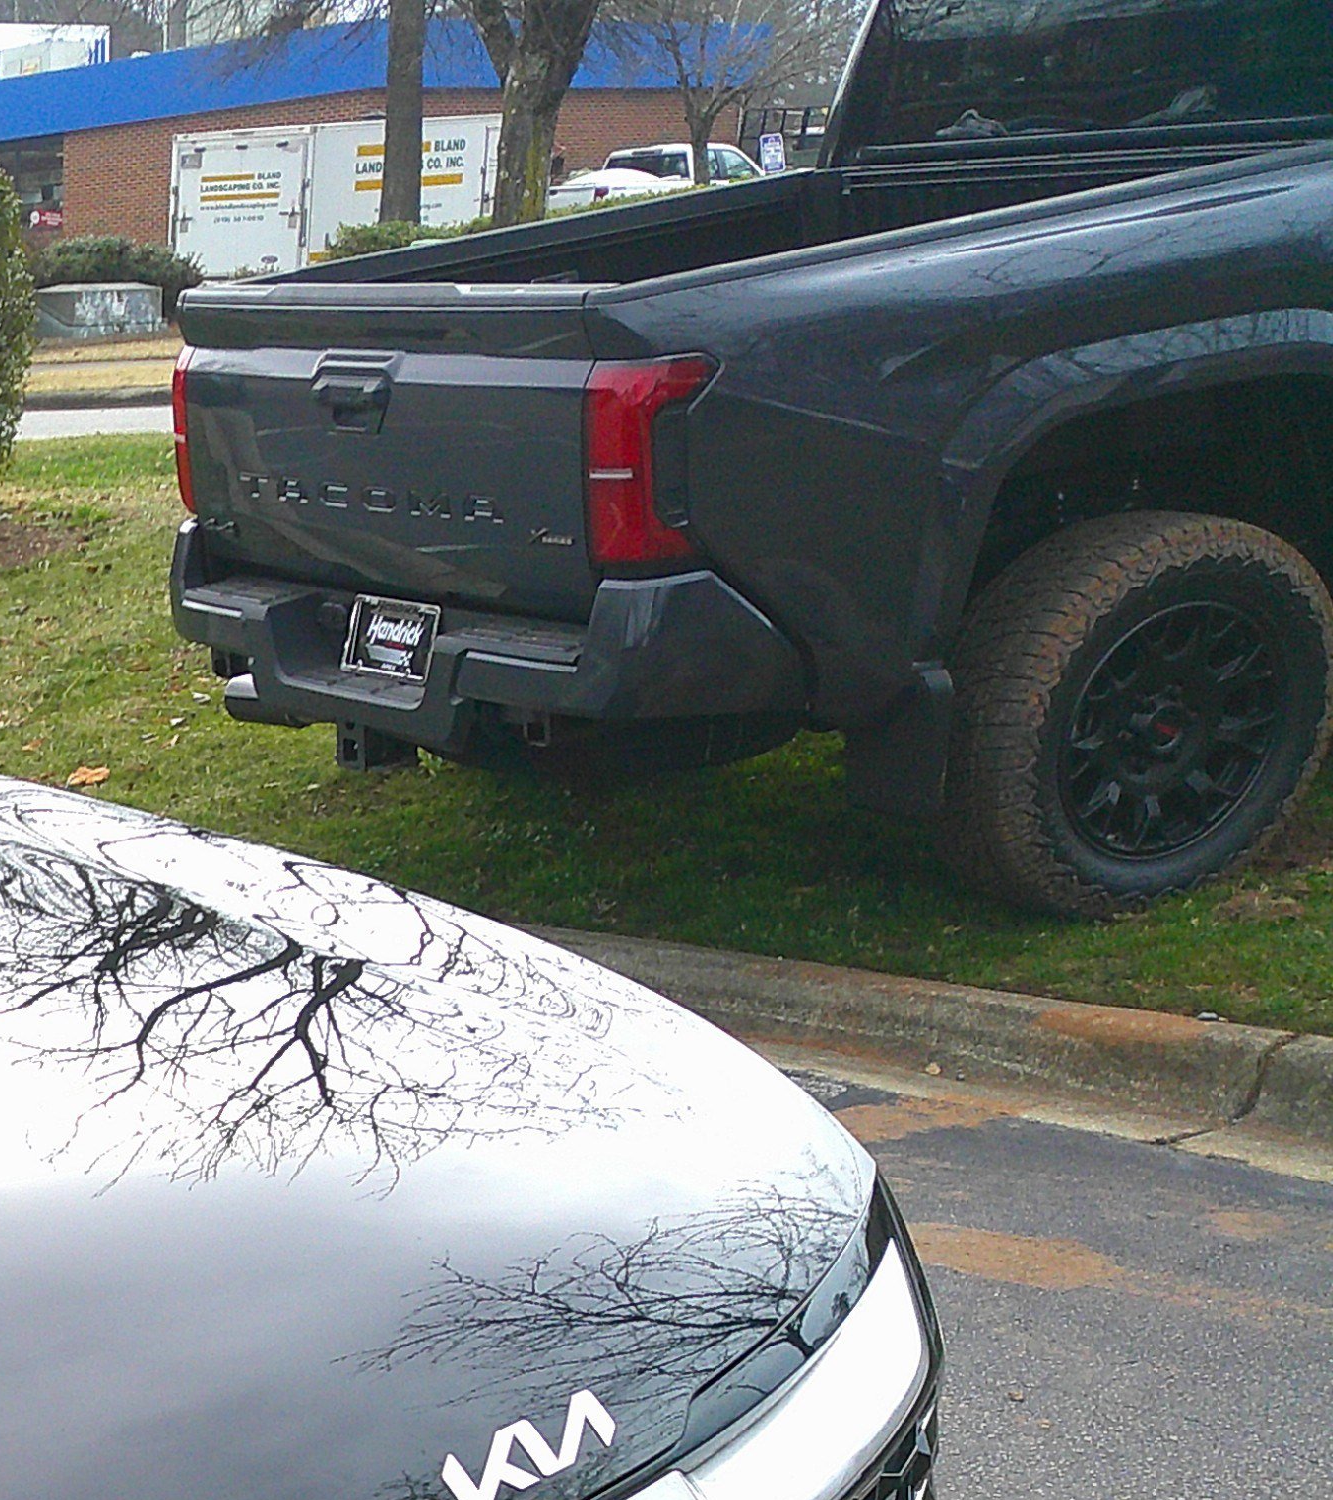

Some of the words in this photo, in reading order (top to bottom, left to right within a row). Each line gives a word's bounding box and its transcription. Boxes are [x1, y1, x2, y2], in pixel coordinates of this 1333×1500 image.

[434, 138, 466, 152] BLAND
[427, 159, 443, 170] CO.
[446, 157, 465, 168] INC.
[257, 171, 282, 180] BLAND
[200, 182, 251, 193] LANDSCAPING
[239, 471, 504, 525] TACOMA
[366, 613, 425, 647] Hendrick
